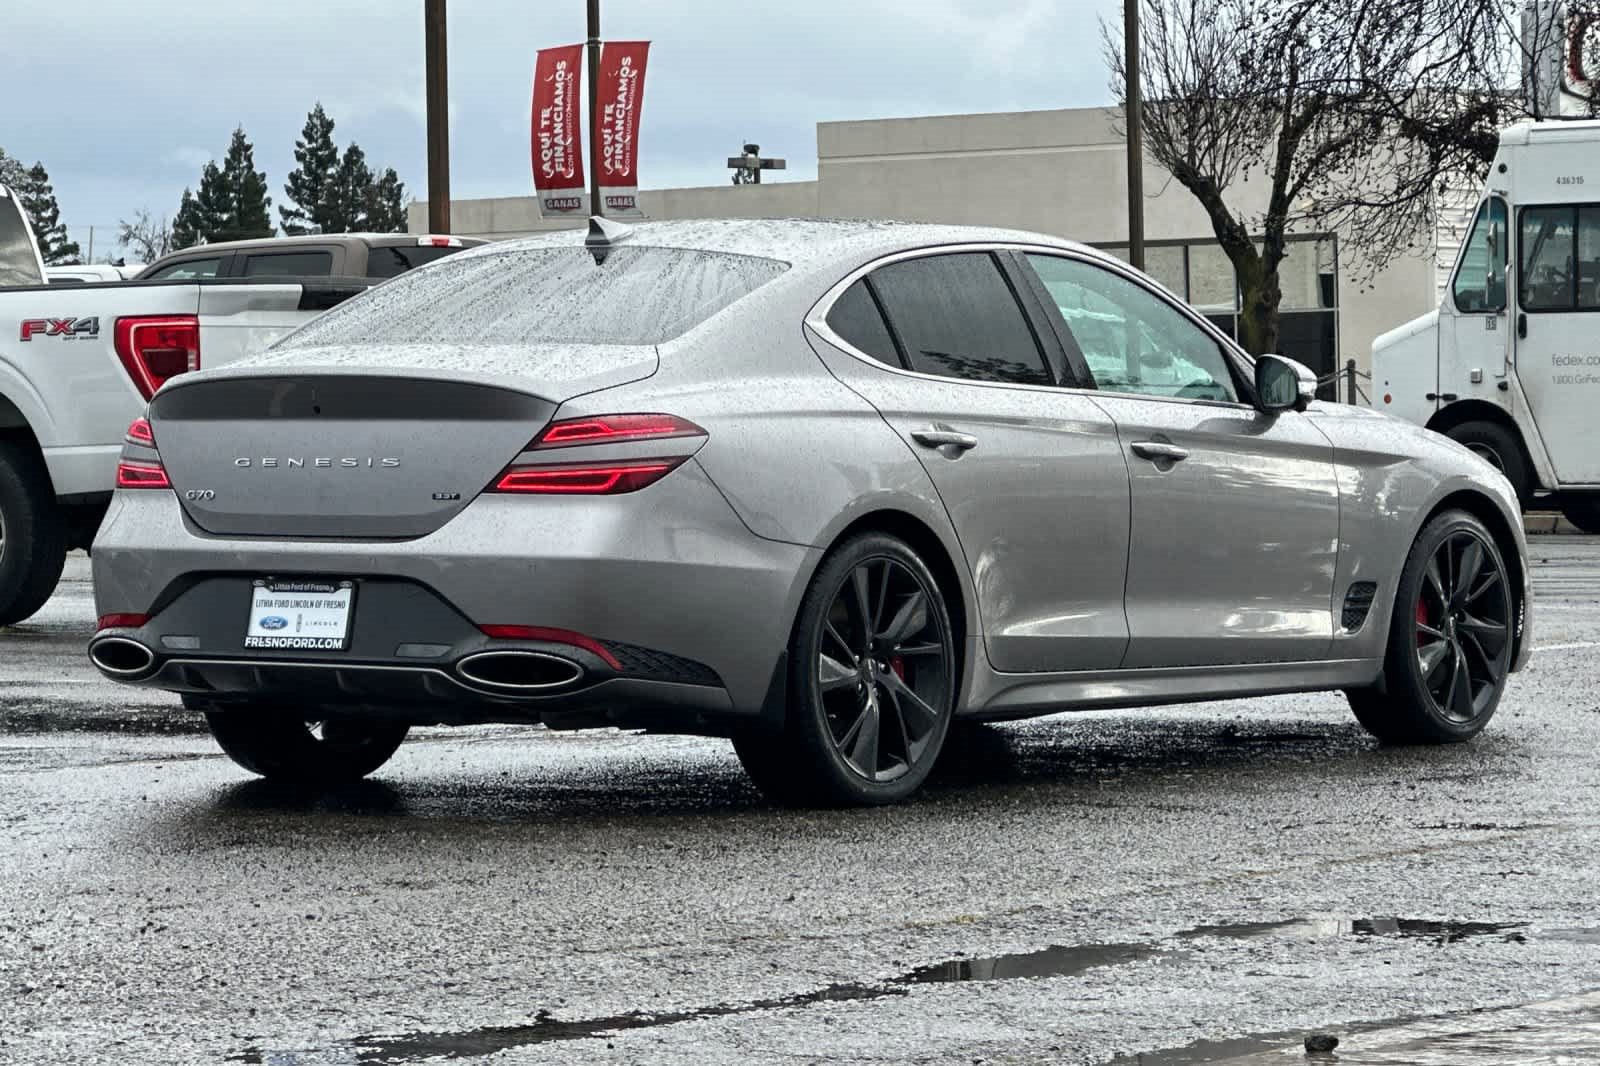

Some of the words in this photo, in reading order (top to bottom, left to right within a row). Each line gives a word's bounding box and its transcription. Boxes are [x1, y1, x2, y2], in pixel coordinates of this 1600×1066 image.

[541, 105, 552, 128] TE
[553, 60, 567, 173] FINANCIAMOS
[604, 103, 615, 126] TE
[614, 56, 632, 170] FINANCIAMOS
[539, 132, 553, 177] AQUÍ
[602, 128, 614, 174] AQUÍ
[546, 198, 580, 209] GANAS
[606, 197, 634, 206] GANAS
[20, 316, 99, 341] FX4
[234, 457, 401, 467] GENESIS
[186, 489, 215, 500] G70
[256, 600, 273, 608] LITHIA
[274, 600, 290, 608] FORD
[290, 600, 314, 608] LINCOLN
[315, 600, 323, 608] OF
[324, 600, 346, 609] FRESNO
[244, 637, 343, 648] FRESNOFORD.COM
